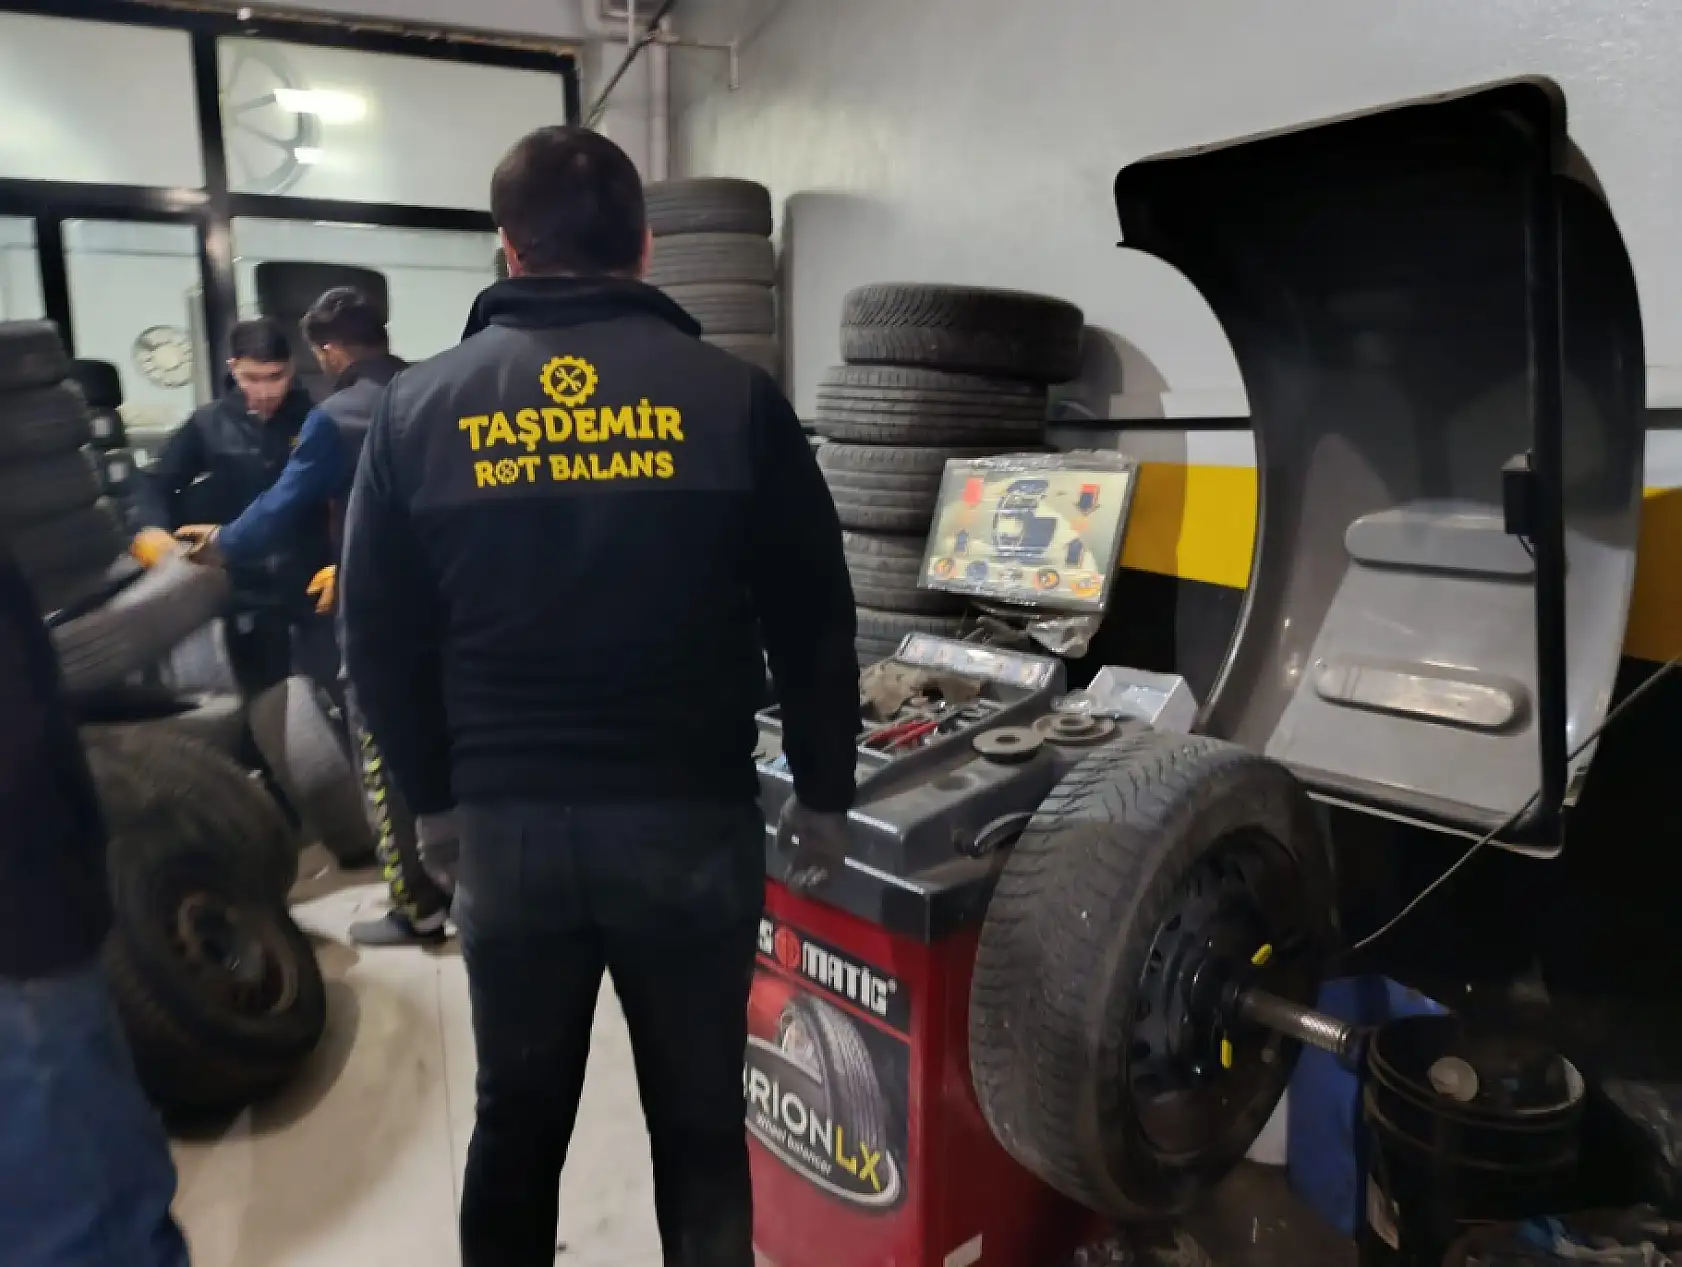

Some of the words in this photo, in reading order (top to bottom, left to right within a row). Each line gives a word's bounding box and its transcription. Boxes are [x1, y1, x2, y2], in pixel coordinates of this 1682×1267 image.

[459, 397, 685, 452] TAŞDEMİR
[474, 455, 541, 488] ROT
[549, 450, 675, 482] BALANS
[743, 1061, 832, 1157] RION
